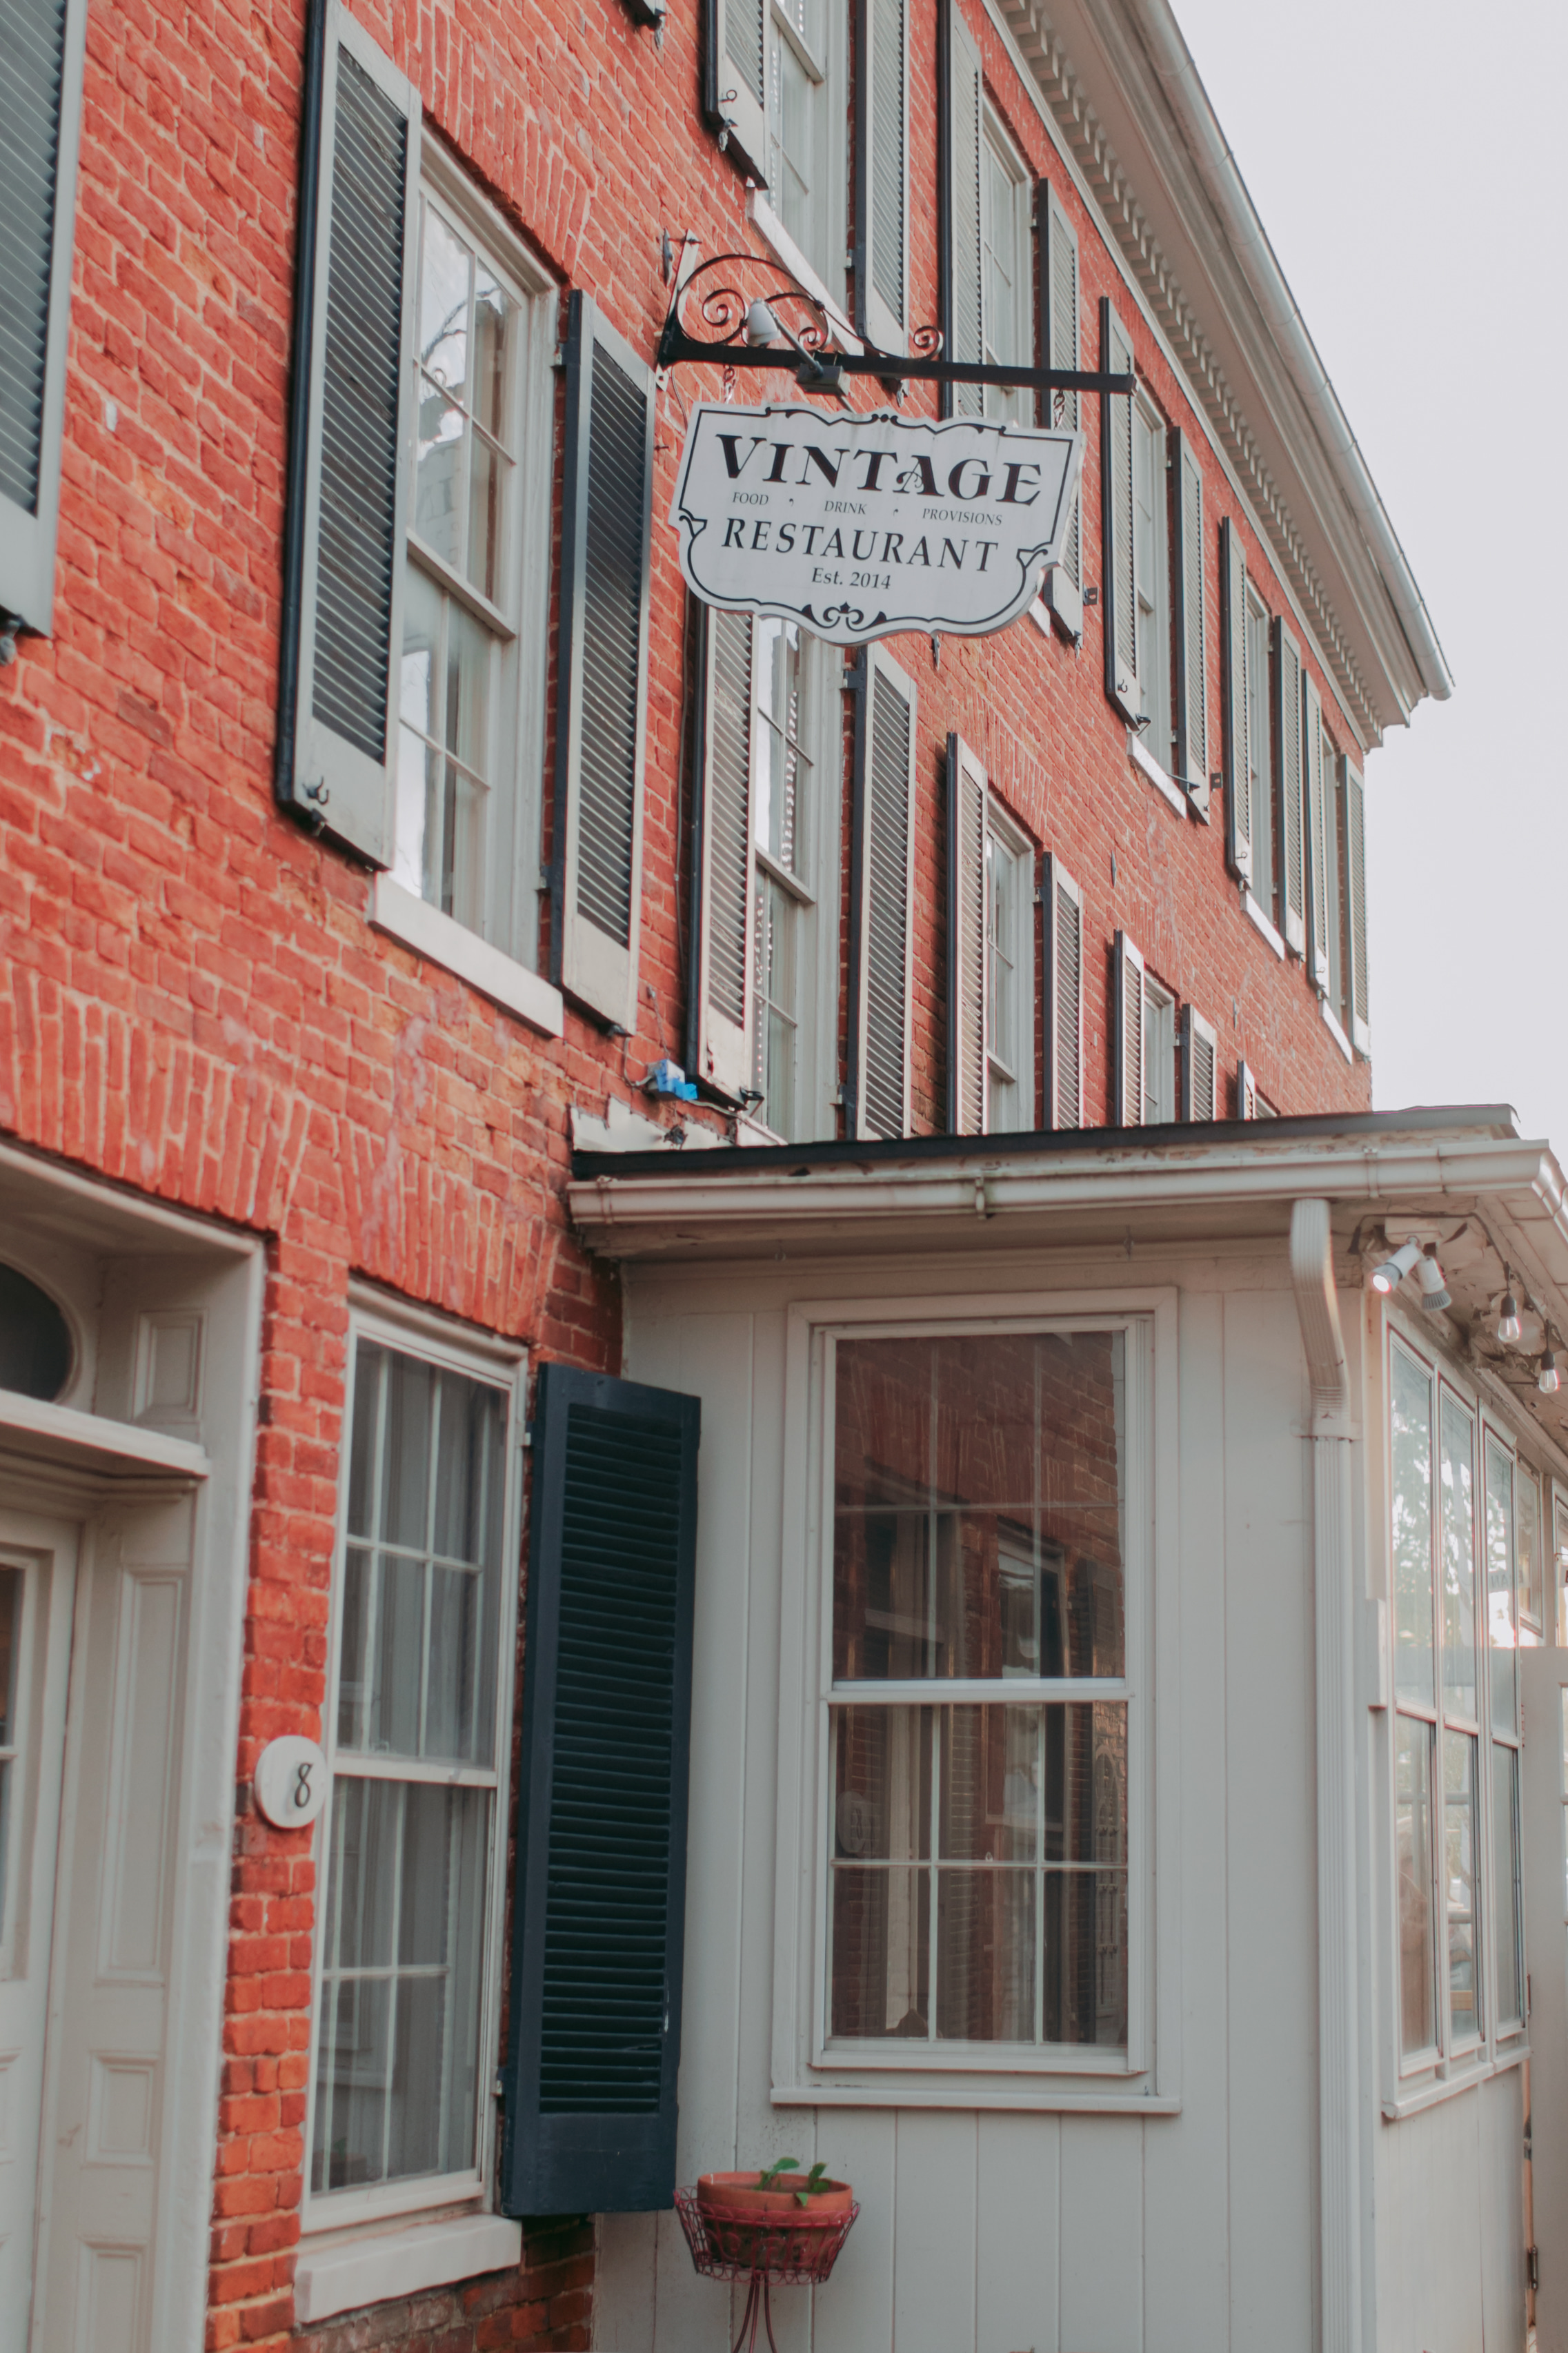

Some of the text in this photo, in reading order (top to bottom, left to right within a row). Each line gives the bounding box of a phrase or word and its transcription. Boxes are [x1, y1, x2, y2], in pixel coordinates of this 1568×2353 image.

[715, 433, 1042, 506] VINTAGE
[732, 491, 1003, 525] FOOD DRINK PROVISIONS
[721, 517, 999, 572] RESTAURANT
[811, 567, 891, 590] Est. 2014
[295, 1762, 313, 1808] 8
